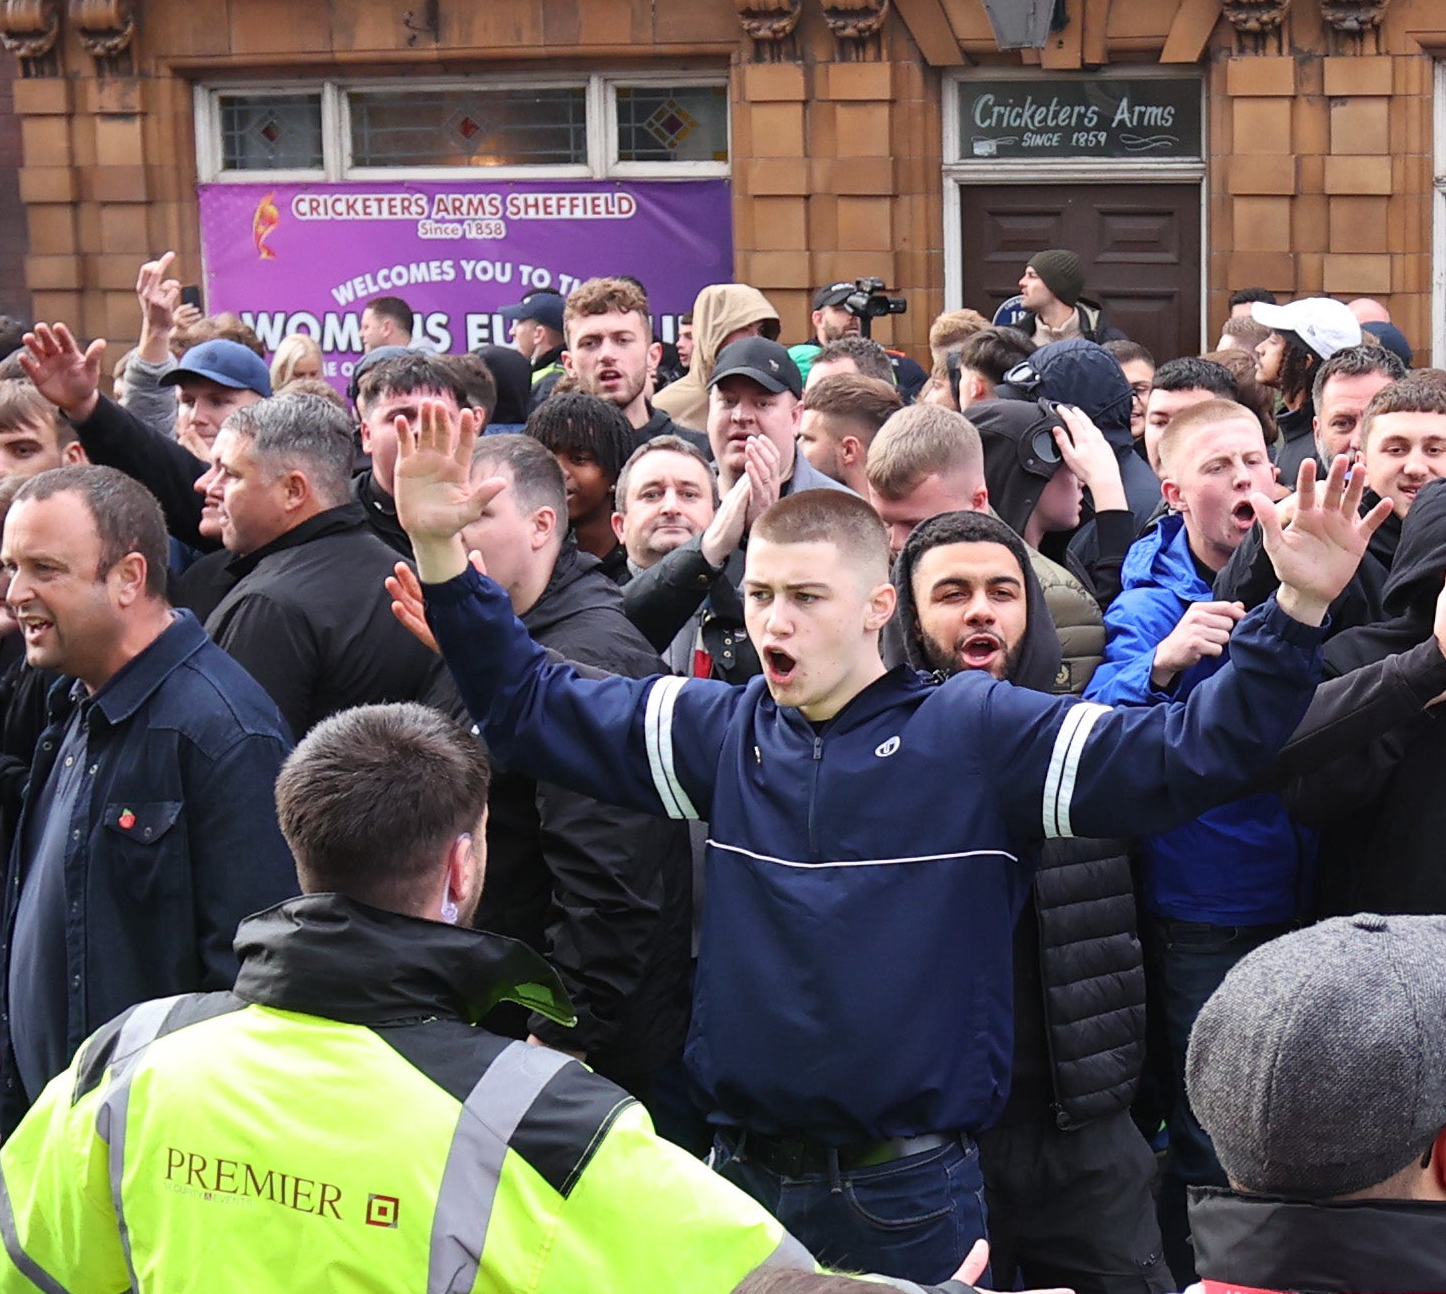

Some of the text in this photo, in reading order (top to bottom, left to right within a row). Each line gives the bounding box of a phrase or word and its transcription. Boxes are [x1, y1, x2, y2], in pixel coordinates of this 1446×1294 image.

[972, 93, 1176, 130] Cricketers Arms
[1021, 131, 1108, 147] SINCE 1859
[293, 193, 636, 218] CRICKETERS ARMS SHEFFIELD
[419, 220, 506, 238] Since 1858
[331, 259, 455, 307] WELCOMES
[460, 260, 513, 284] YOU
[518, 264, 552, 289] TO
[164, 1147, 344, 1221] PREMIER
